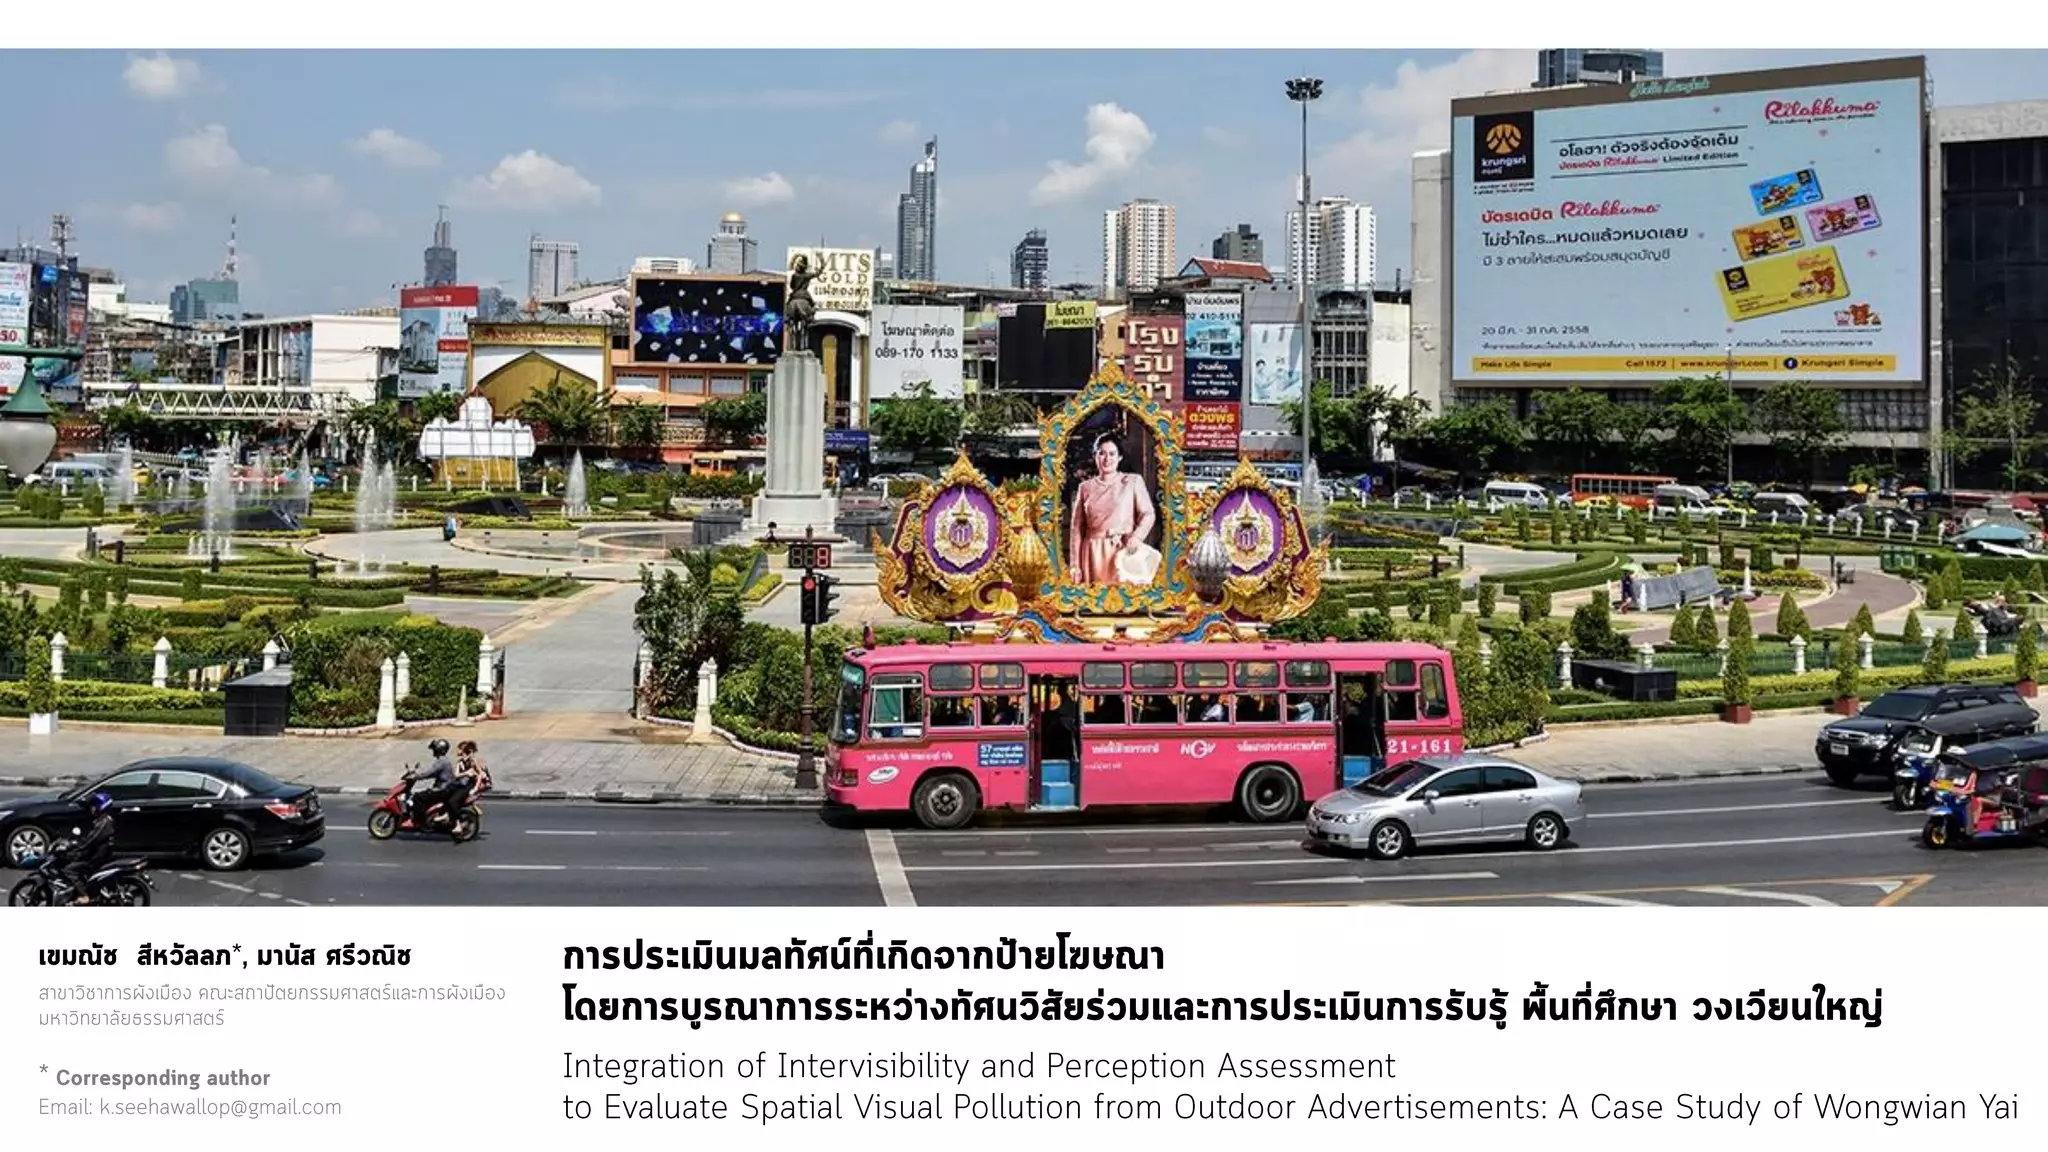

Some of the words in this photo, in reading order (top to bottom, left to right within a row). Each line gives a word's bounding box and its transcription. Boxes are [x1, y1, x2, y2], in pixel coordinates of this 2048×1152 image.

[1765, 97, 1880, 120] Rilakkuma
[1559, 143, 1607, 158] อโลฮา!
[1610, 134, 1739, 155] ตัวจริงต้องจัดเต็ม
[1481, 155, 1526, 167] krungsri
[1663, 153, 1700, 163] Limited
[1702, 151, 1739, 162] Edition
[1482, 207, 1553, 223] บัตรเดบิต
[1560, 200, 1661, 218] Rilakkuma
[1482, 226, 1689, 247] ไม่ซ้ำใคร...หมดแล้วหมดเลย
[814, 253, 871, 272] MTS
[817, 272, 868, 285] GOLD
[1128, 320, 1179, 346] โรง
[1482, 326, 1496, 335] 20
[1526, 326, 1537, 335] 31
[930, 348, 958, 358] 1133
[1134, 347, 1173, 373] รับ
[1626, 360, 1644, 368] Call
[1801, 358, 1846, 368] Krungsri
[1849, 357, 1884, 368] Simple
[1189, 413, 1235, 423] ดวงพร
[1181, 740, 1216, 758] NGV
[1387, 739, 1450, 753] 21-161
